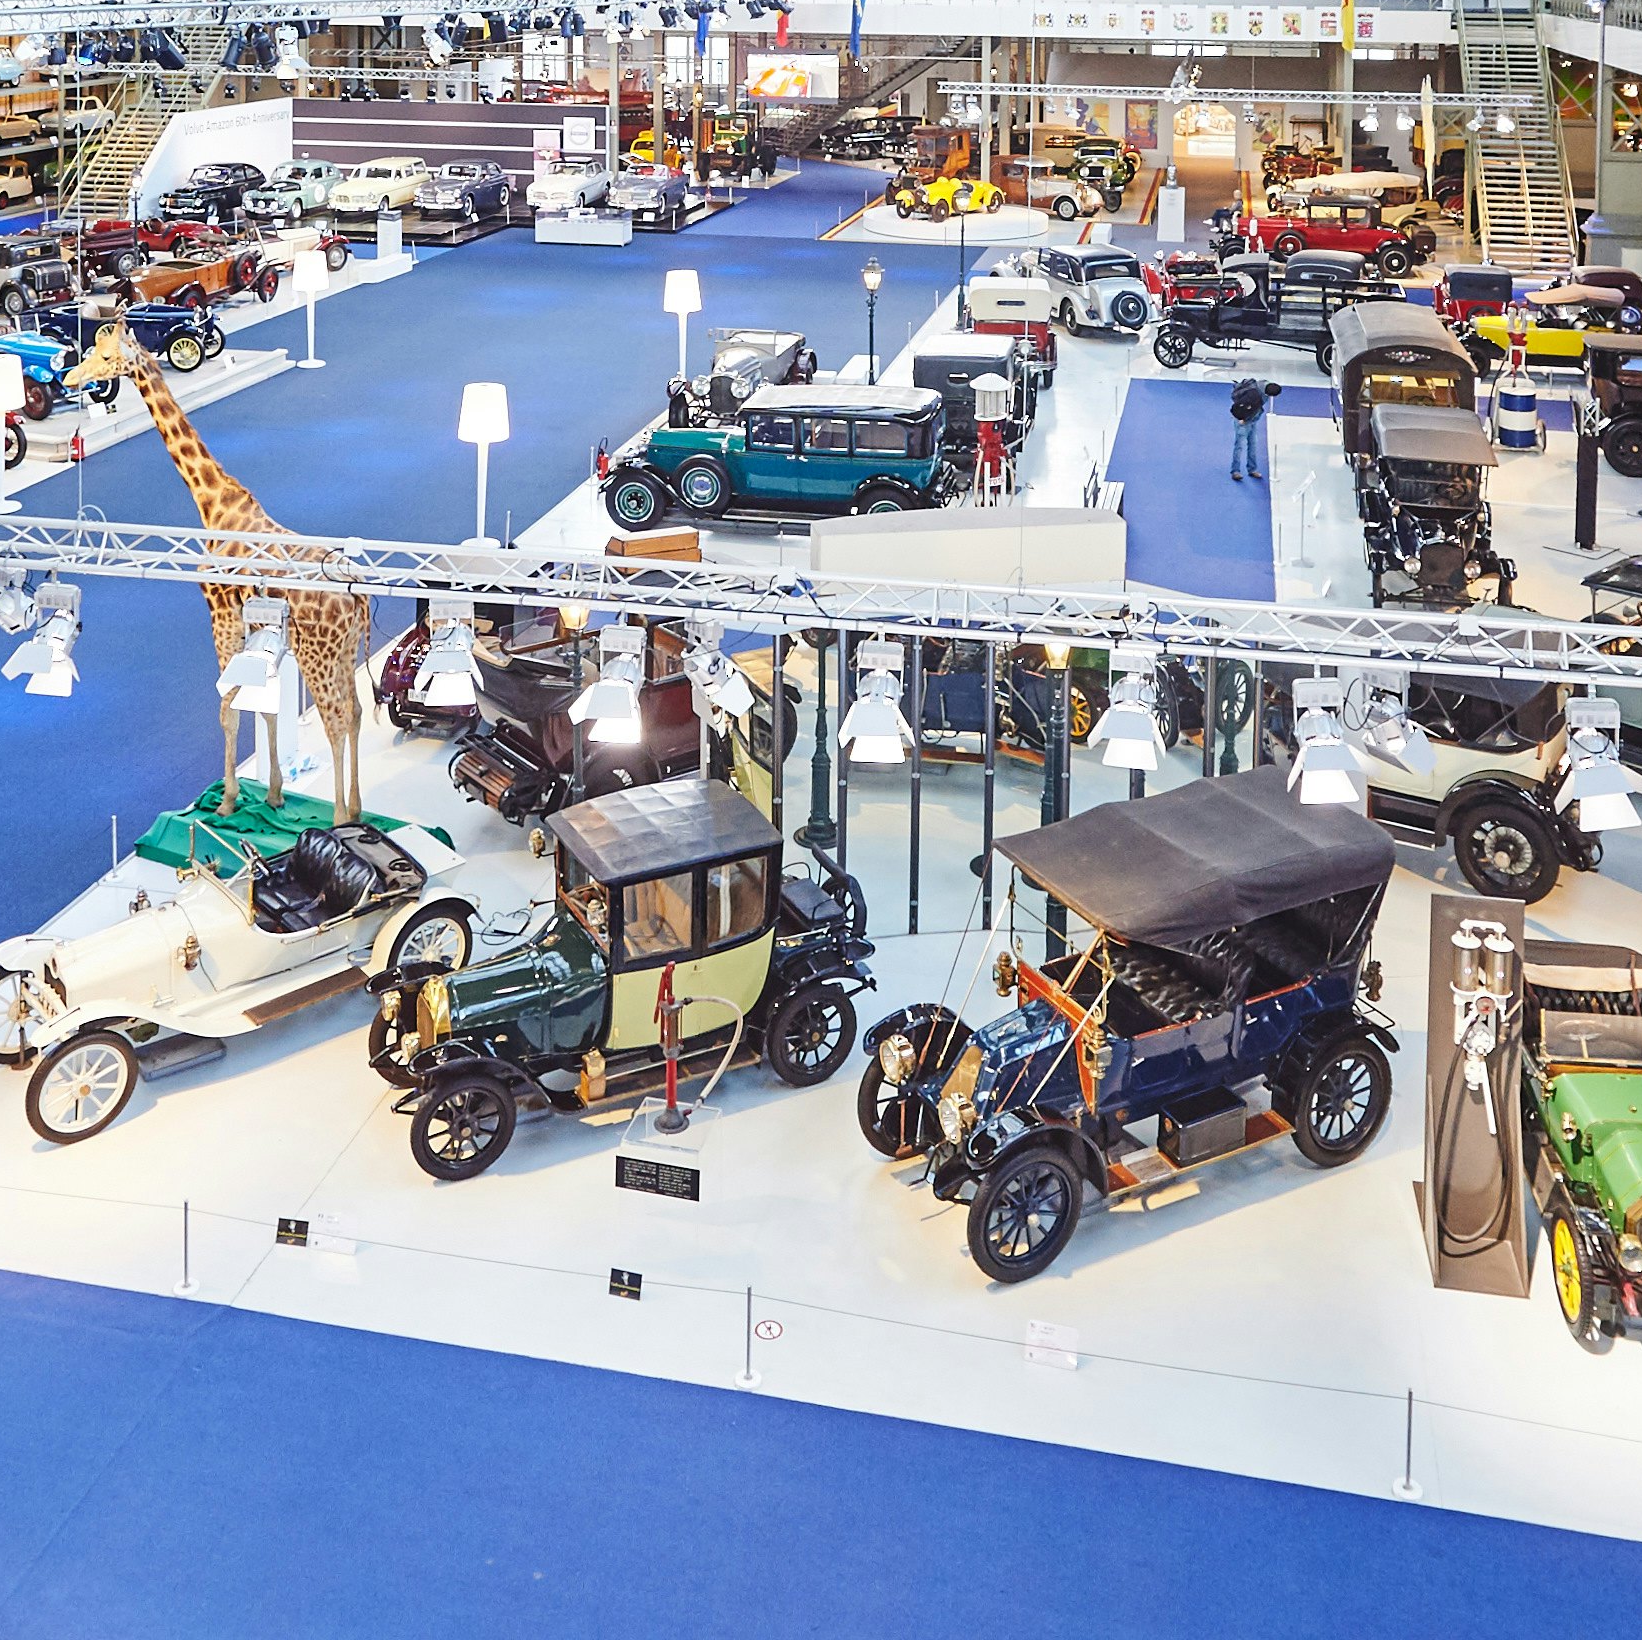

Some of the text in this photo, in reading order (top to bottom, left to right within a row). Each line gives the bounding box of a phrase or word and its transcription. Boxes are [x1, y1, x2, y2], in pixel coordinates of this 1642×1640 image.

[184, 110, 290, 136] Volvo Amazon 60th Anniversary
